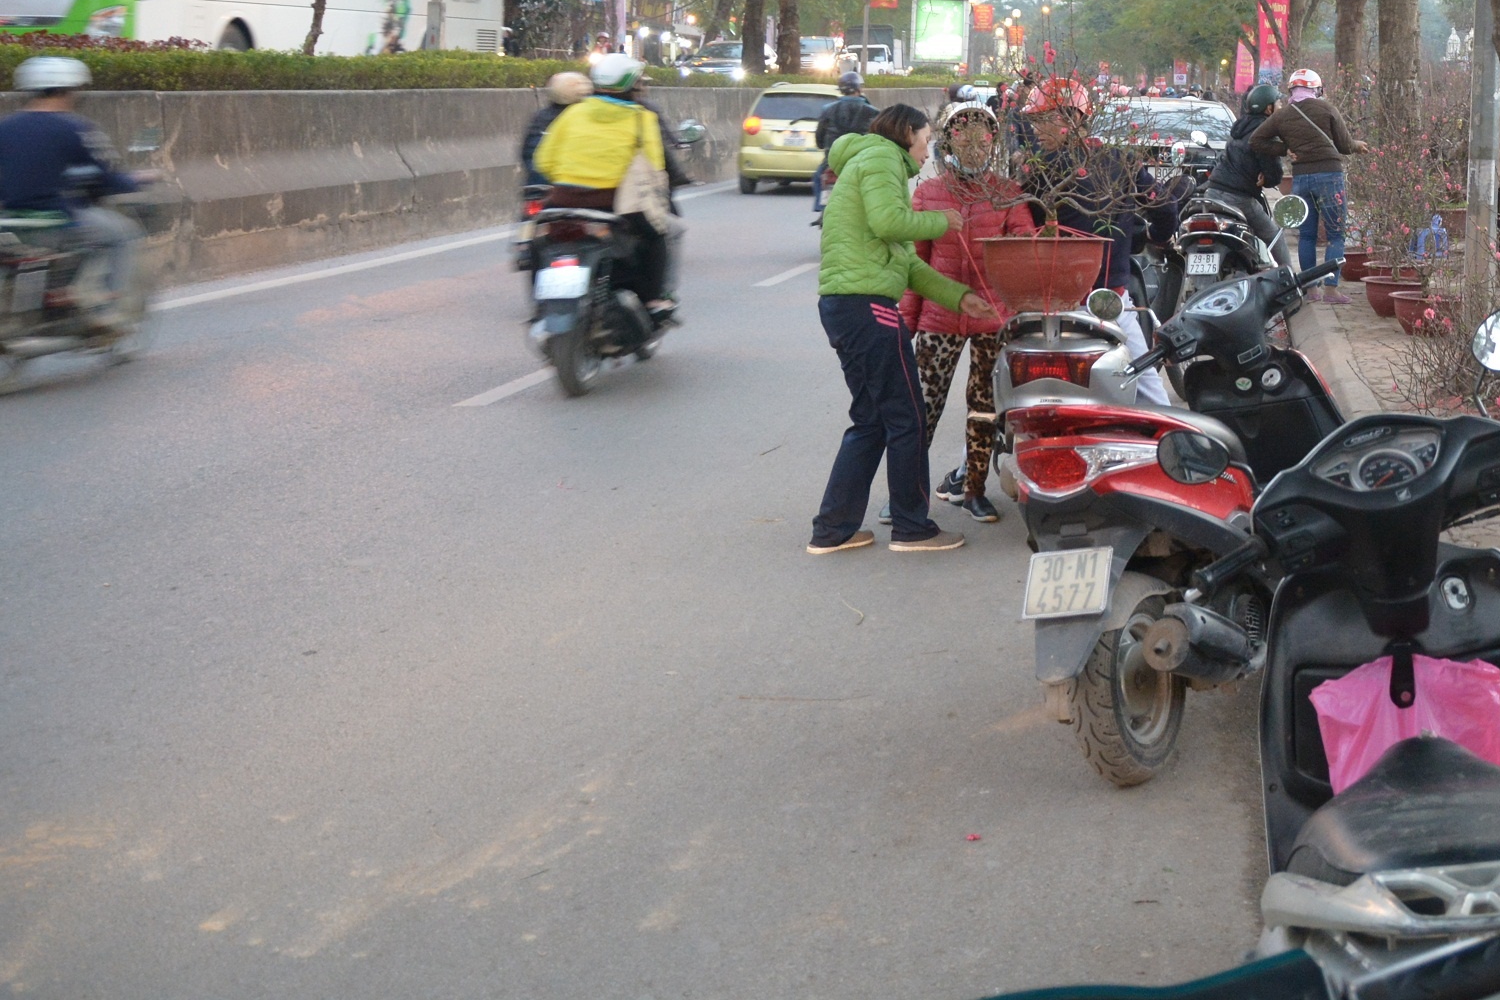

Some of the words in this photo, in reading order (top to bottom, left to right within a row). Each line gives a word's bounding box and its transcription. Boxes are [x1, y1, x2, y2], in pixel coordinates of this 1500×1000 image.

[1190, 264, 1217, 273] 723.76
[1193, 254, 1215, 264] 29-B1
[1041, 552, 1099, 583] 30-N1
[1036, 581, 1096, 612] 4577
